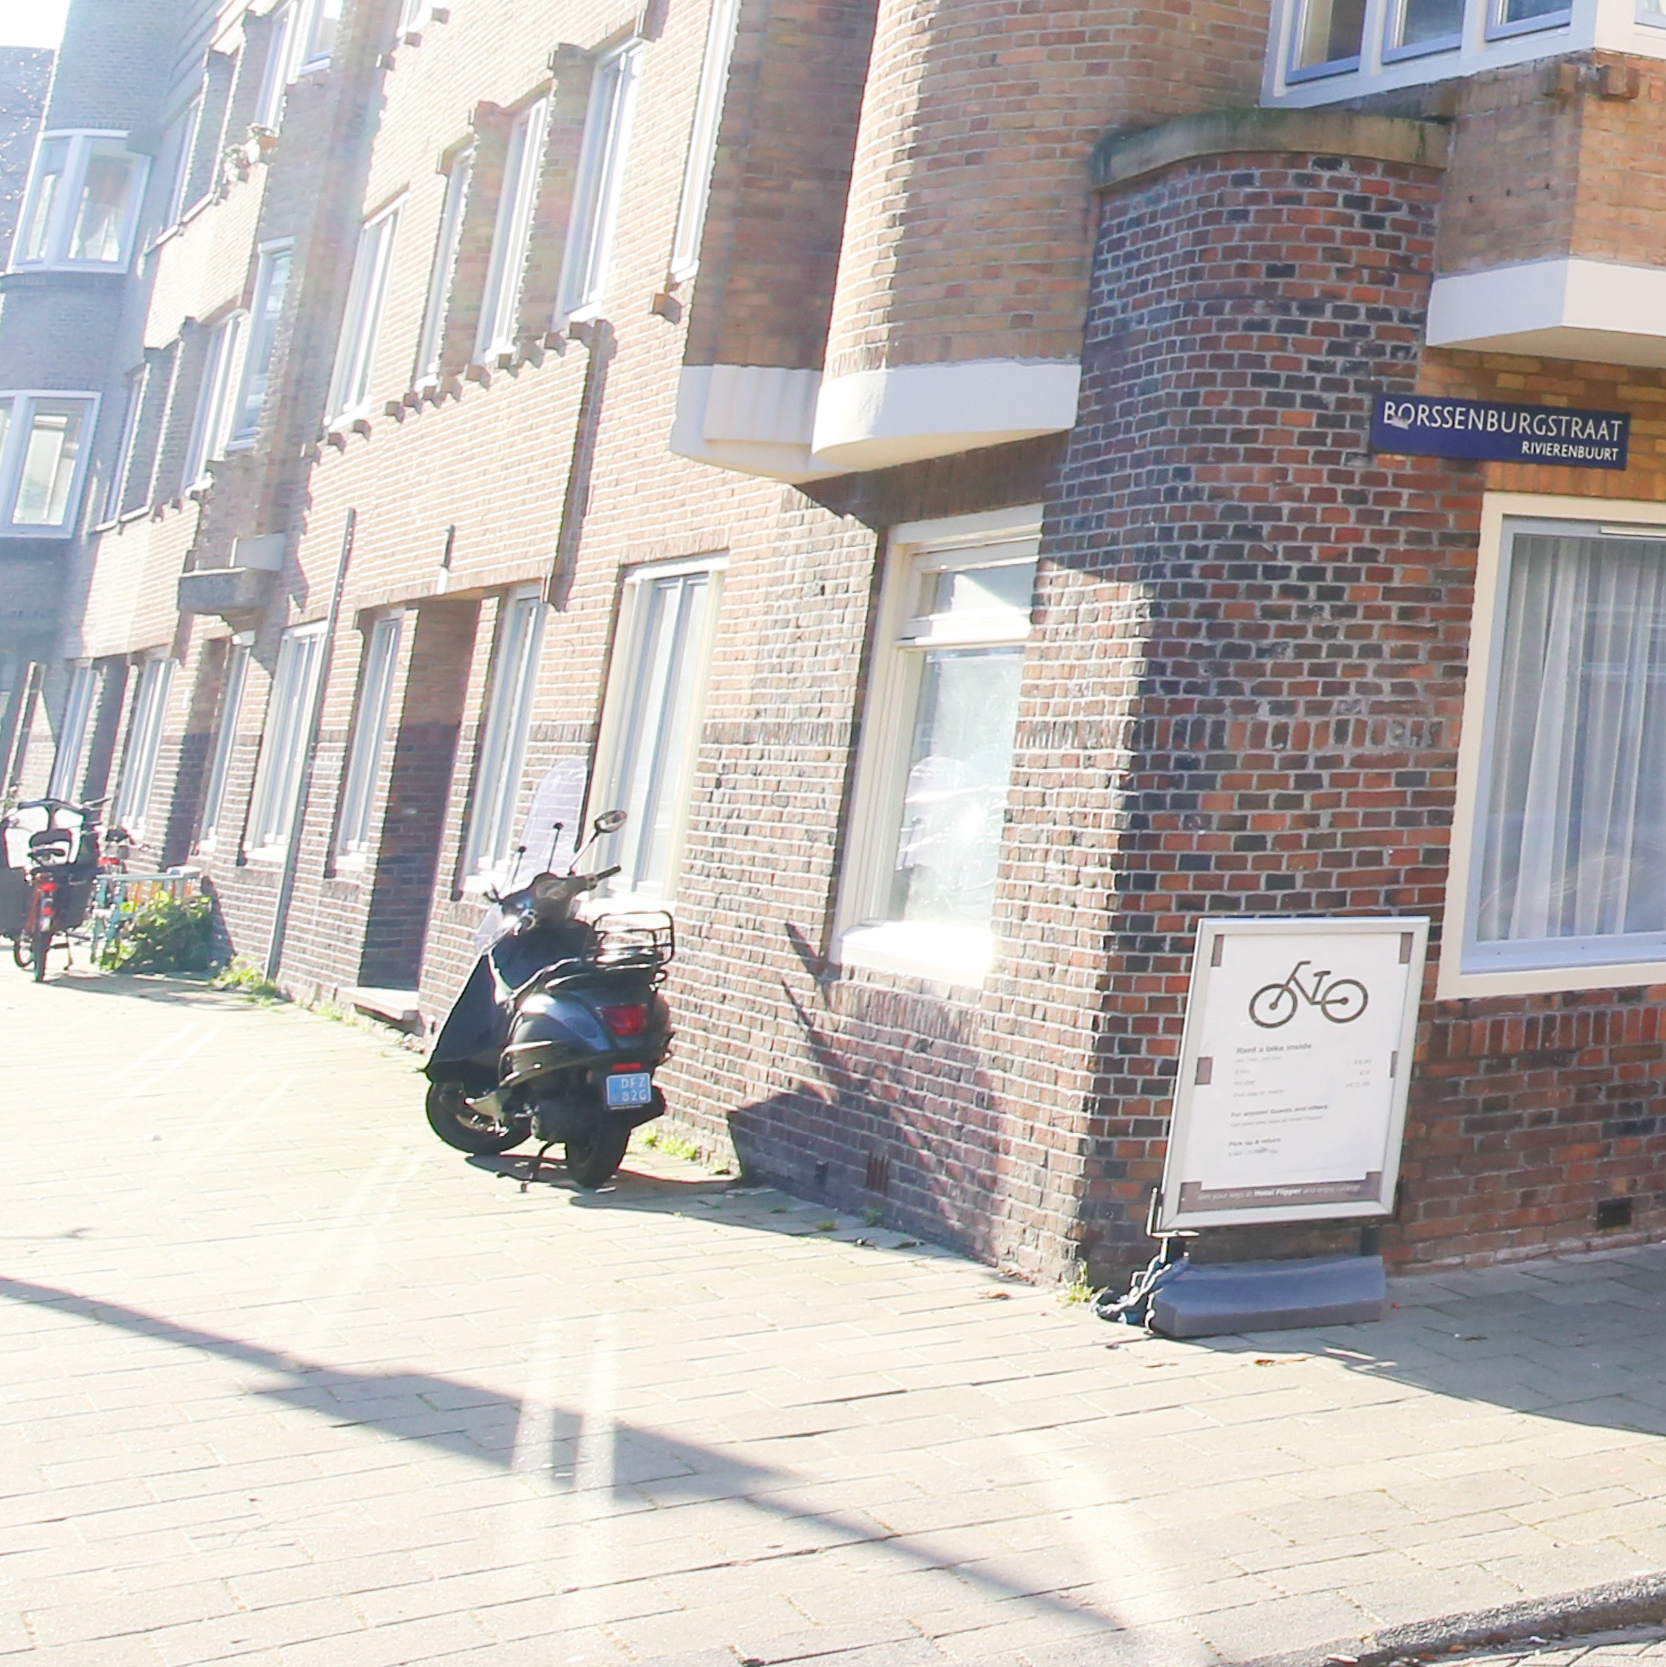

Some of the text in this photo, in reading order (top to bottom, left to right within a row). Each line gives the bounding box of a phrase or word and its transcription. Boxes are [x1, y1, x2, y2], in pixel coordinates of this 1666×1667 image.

[1383, 400, 1623, 442] BORSSENBURGSTRAAT
[1521, 441, 1620, 462] RIVIERENBUURT
[621, 1076, 646, 1089] DFZ
